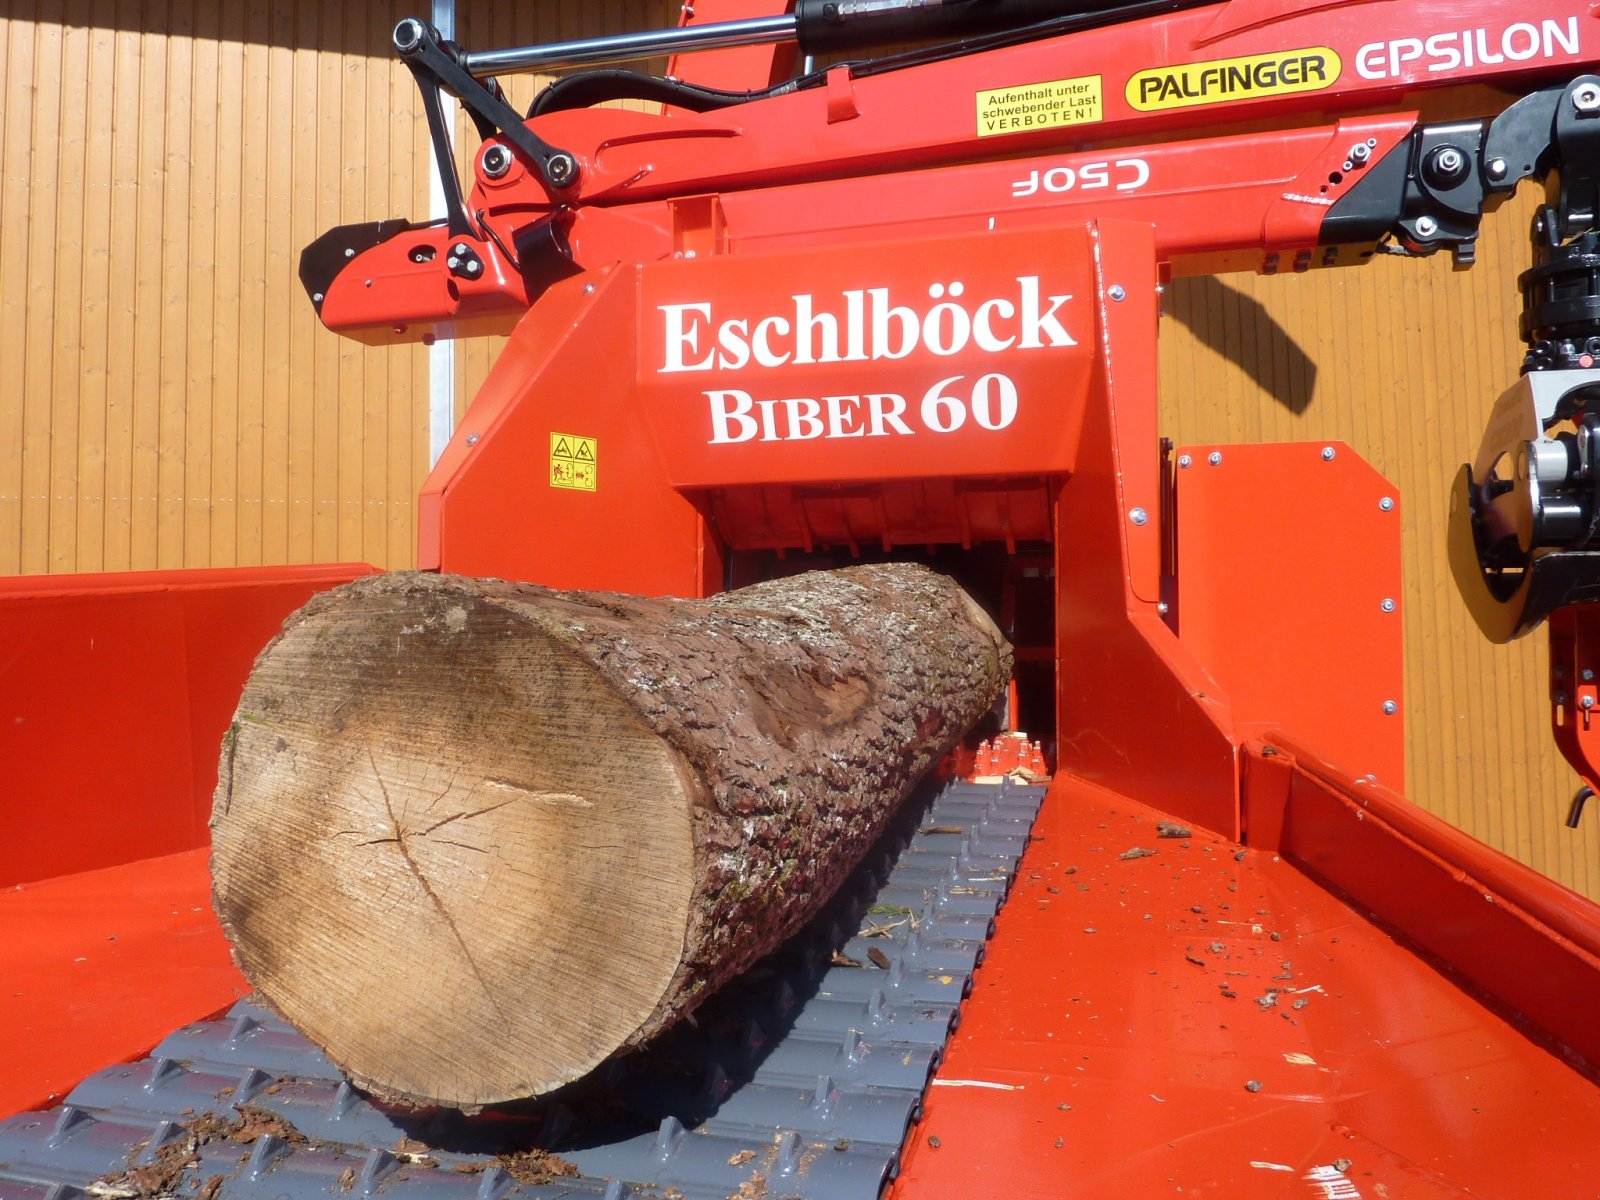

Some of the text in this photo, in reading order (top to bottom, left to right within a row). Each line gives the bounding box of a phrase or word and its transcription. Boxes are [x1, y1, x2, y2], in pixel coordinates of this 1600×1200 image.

[1355, 15, 1581, 81] EPSILON
[988, 84, 1090, 106] Aufenthalt unter
[1140, 55, 1326, 104] PALFINGER
[982, 95, 1097, 119] schwebender Last
[657, 275, 1078, 374] Eschlböck
[920, 373, 1018, 433] 60
